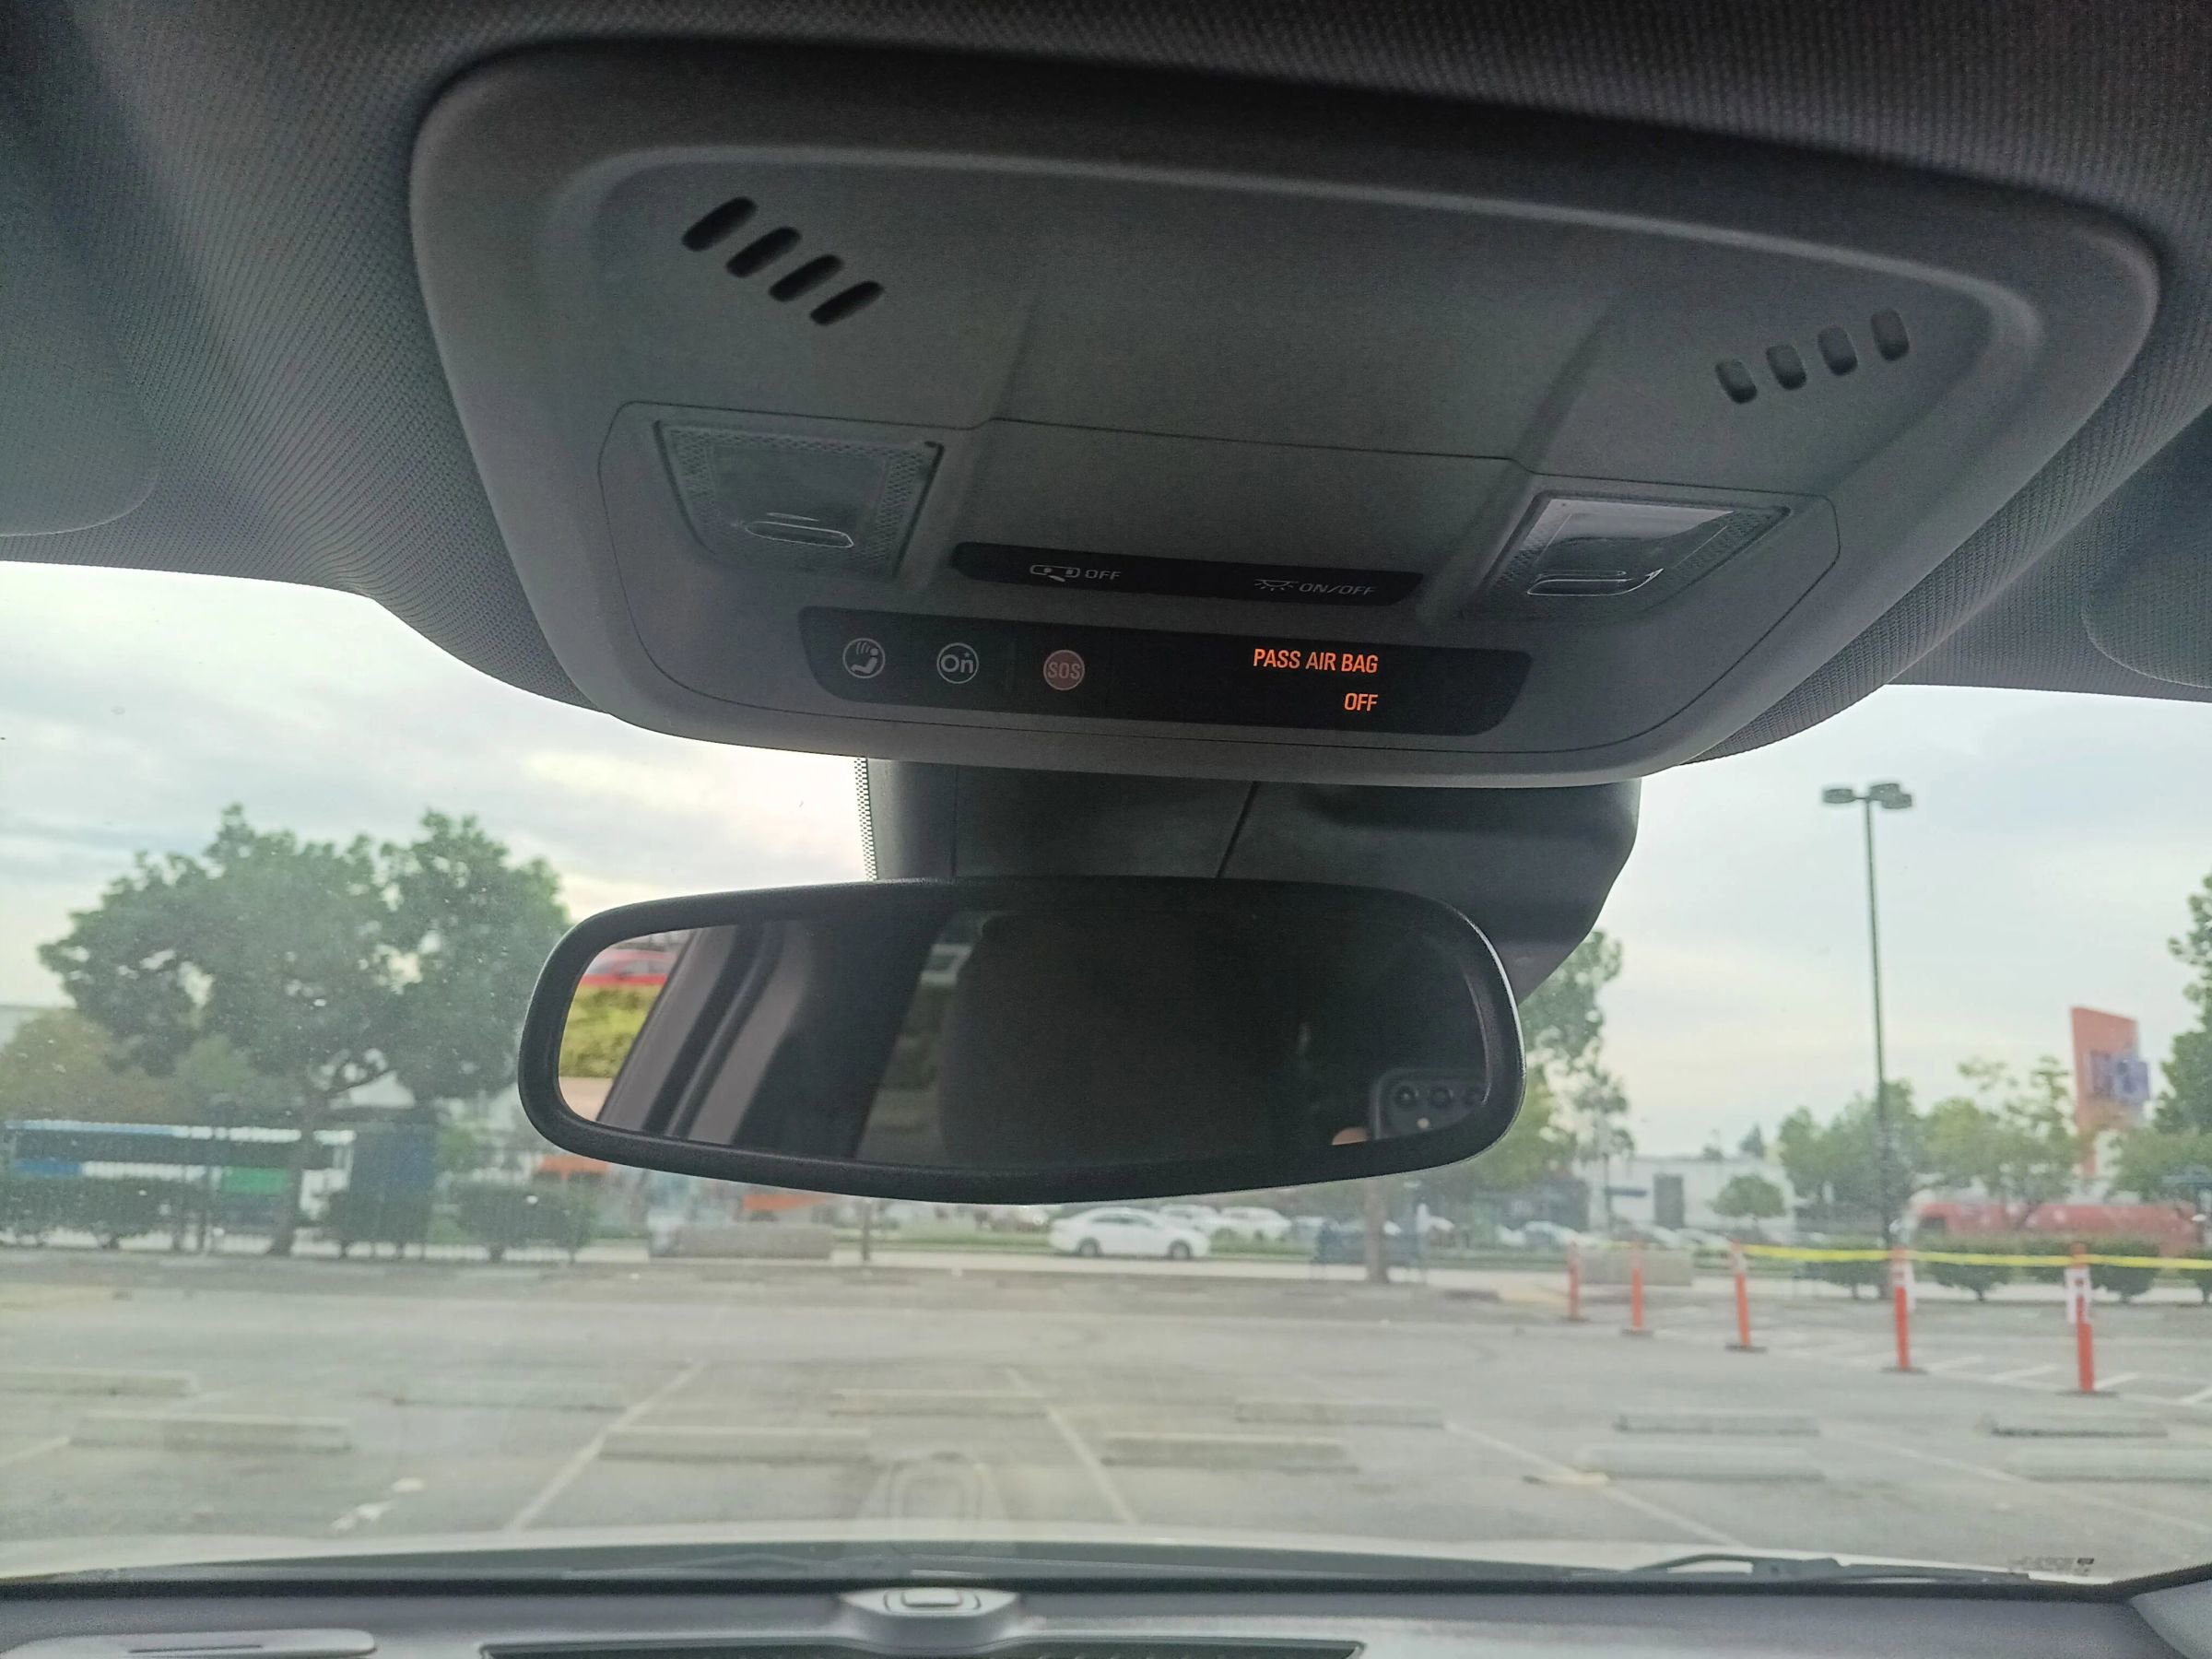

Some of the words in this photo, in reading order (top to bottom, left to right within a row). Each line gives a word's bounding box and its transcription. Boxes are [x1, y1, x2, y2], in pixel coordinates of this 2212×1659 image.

[1084, 569, 1122, 582] OFF
[1299, 581, 1377, 596] ON/OFF
[1046, 660, 1082, 680] SOS
[1253, 648, 1301, 669] PASS
[1305, 651, 1336, 671] AIR
[1341, 653, 1379, 674] BAG
[1344, 692, 1379, 712] OFF
